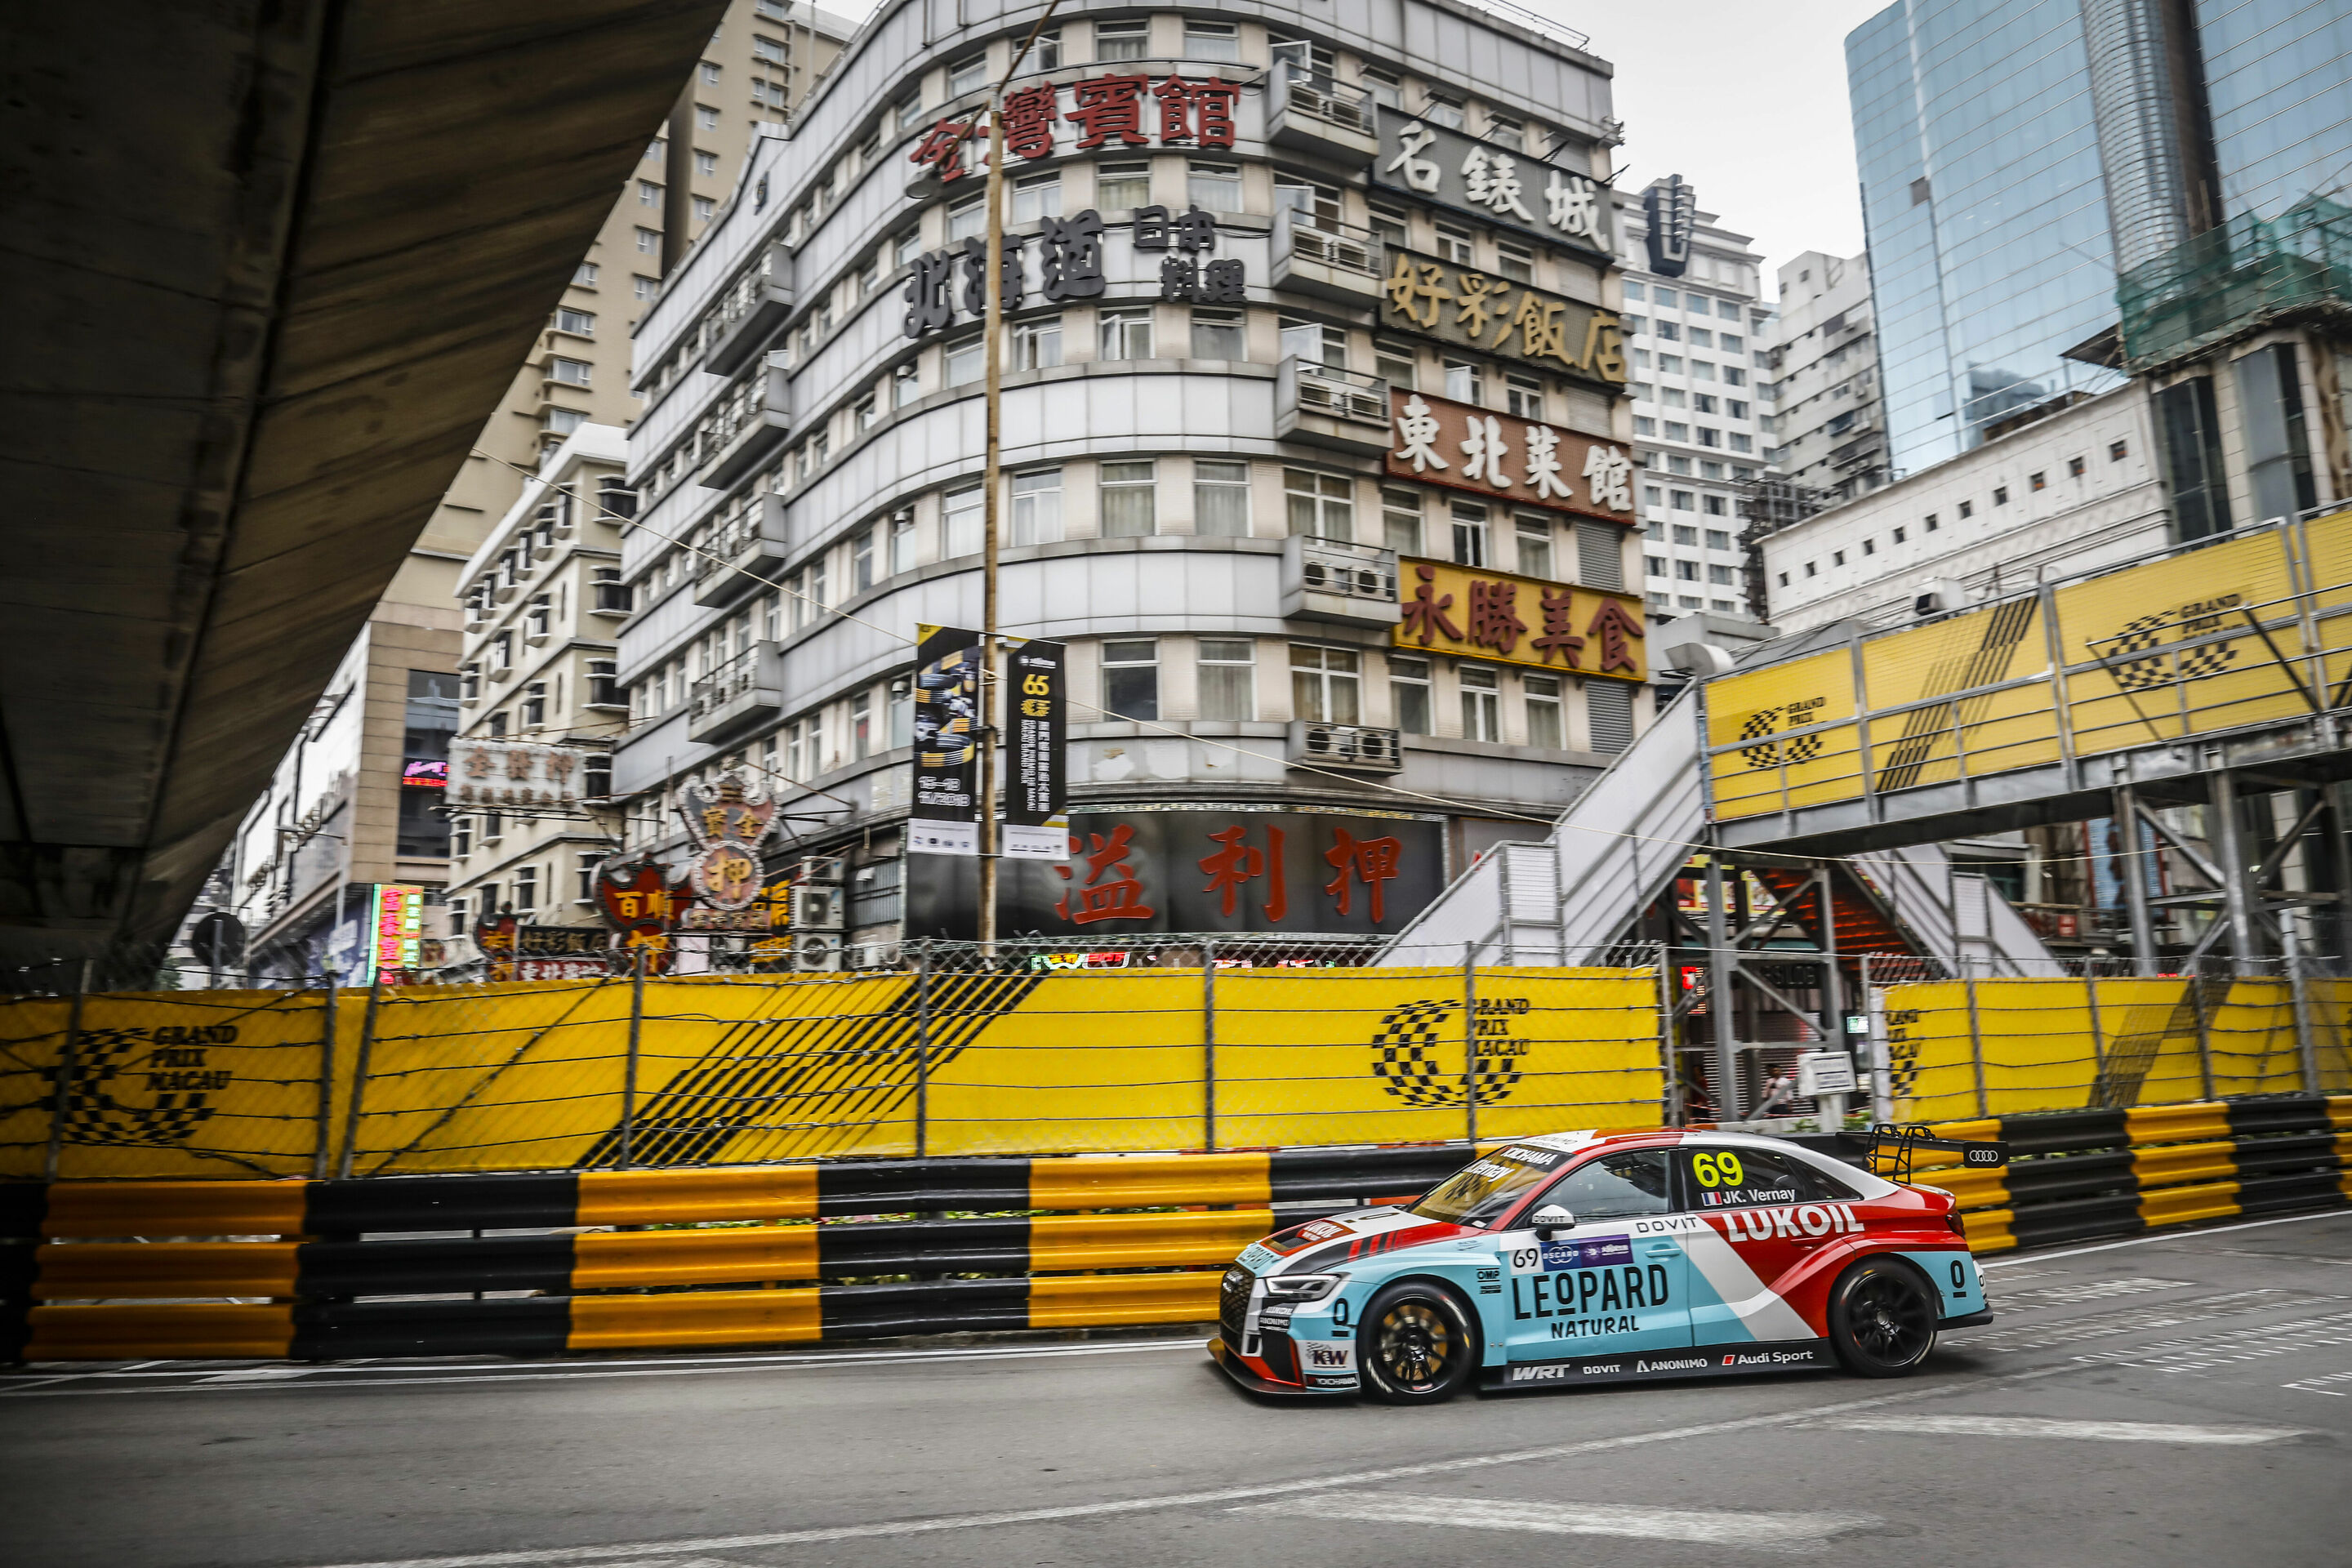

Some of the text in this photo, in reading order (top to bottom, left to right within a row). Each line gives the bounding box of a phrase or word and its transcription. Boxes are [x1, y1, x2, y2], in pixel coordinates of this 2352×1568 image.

[1387, 120, 1610, 253] 名錶城
[903, 208, 1107, 340] 北海道
[1388, 253, 1628, 385] 好彩飯店
[1394, 394, 1633, 512] 東北菜館
[1401, 564, 1646, 672] 永勝美食
[1022, 674, 1050, 696] 65
[1054, 823, 1403, 924] 溢利押
[153, 1025, 238, 1045] GRAND
[145, 1070, 233, 1091] MACAU
[1692, 1152, 1744, 1188] 69
[1722, 1189, 1796, 1205] JK. Vernay
[1636, 1217, 1698, 1234] DOVIT
[1721, 1204, 1865, 1242] LUKOIL
[1513, 1248, 1539, 1268] 69
[1512, 1264, 1668, 1320] LEOPARD
[1551, 1315, 1640, 1339] NATURAL
[1512, 1350, 1814, 1381] WRT DOVIT ANONIMO Audi Sport
